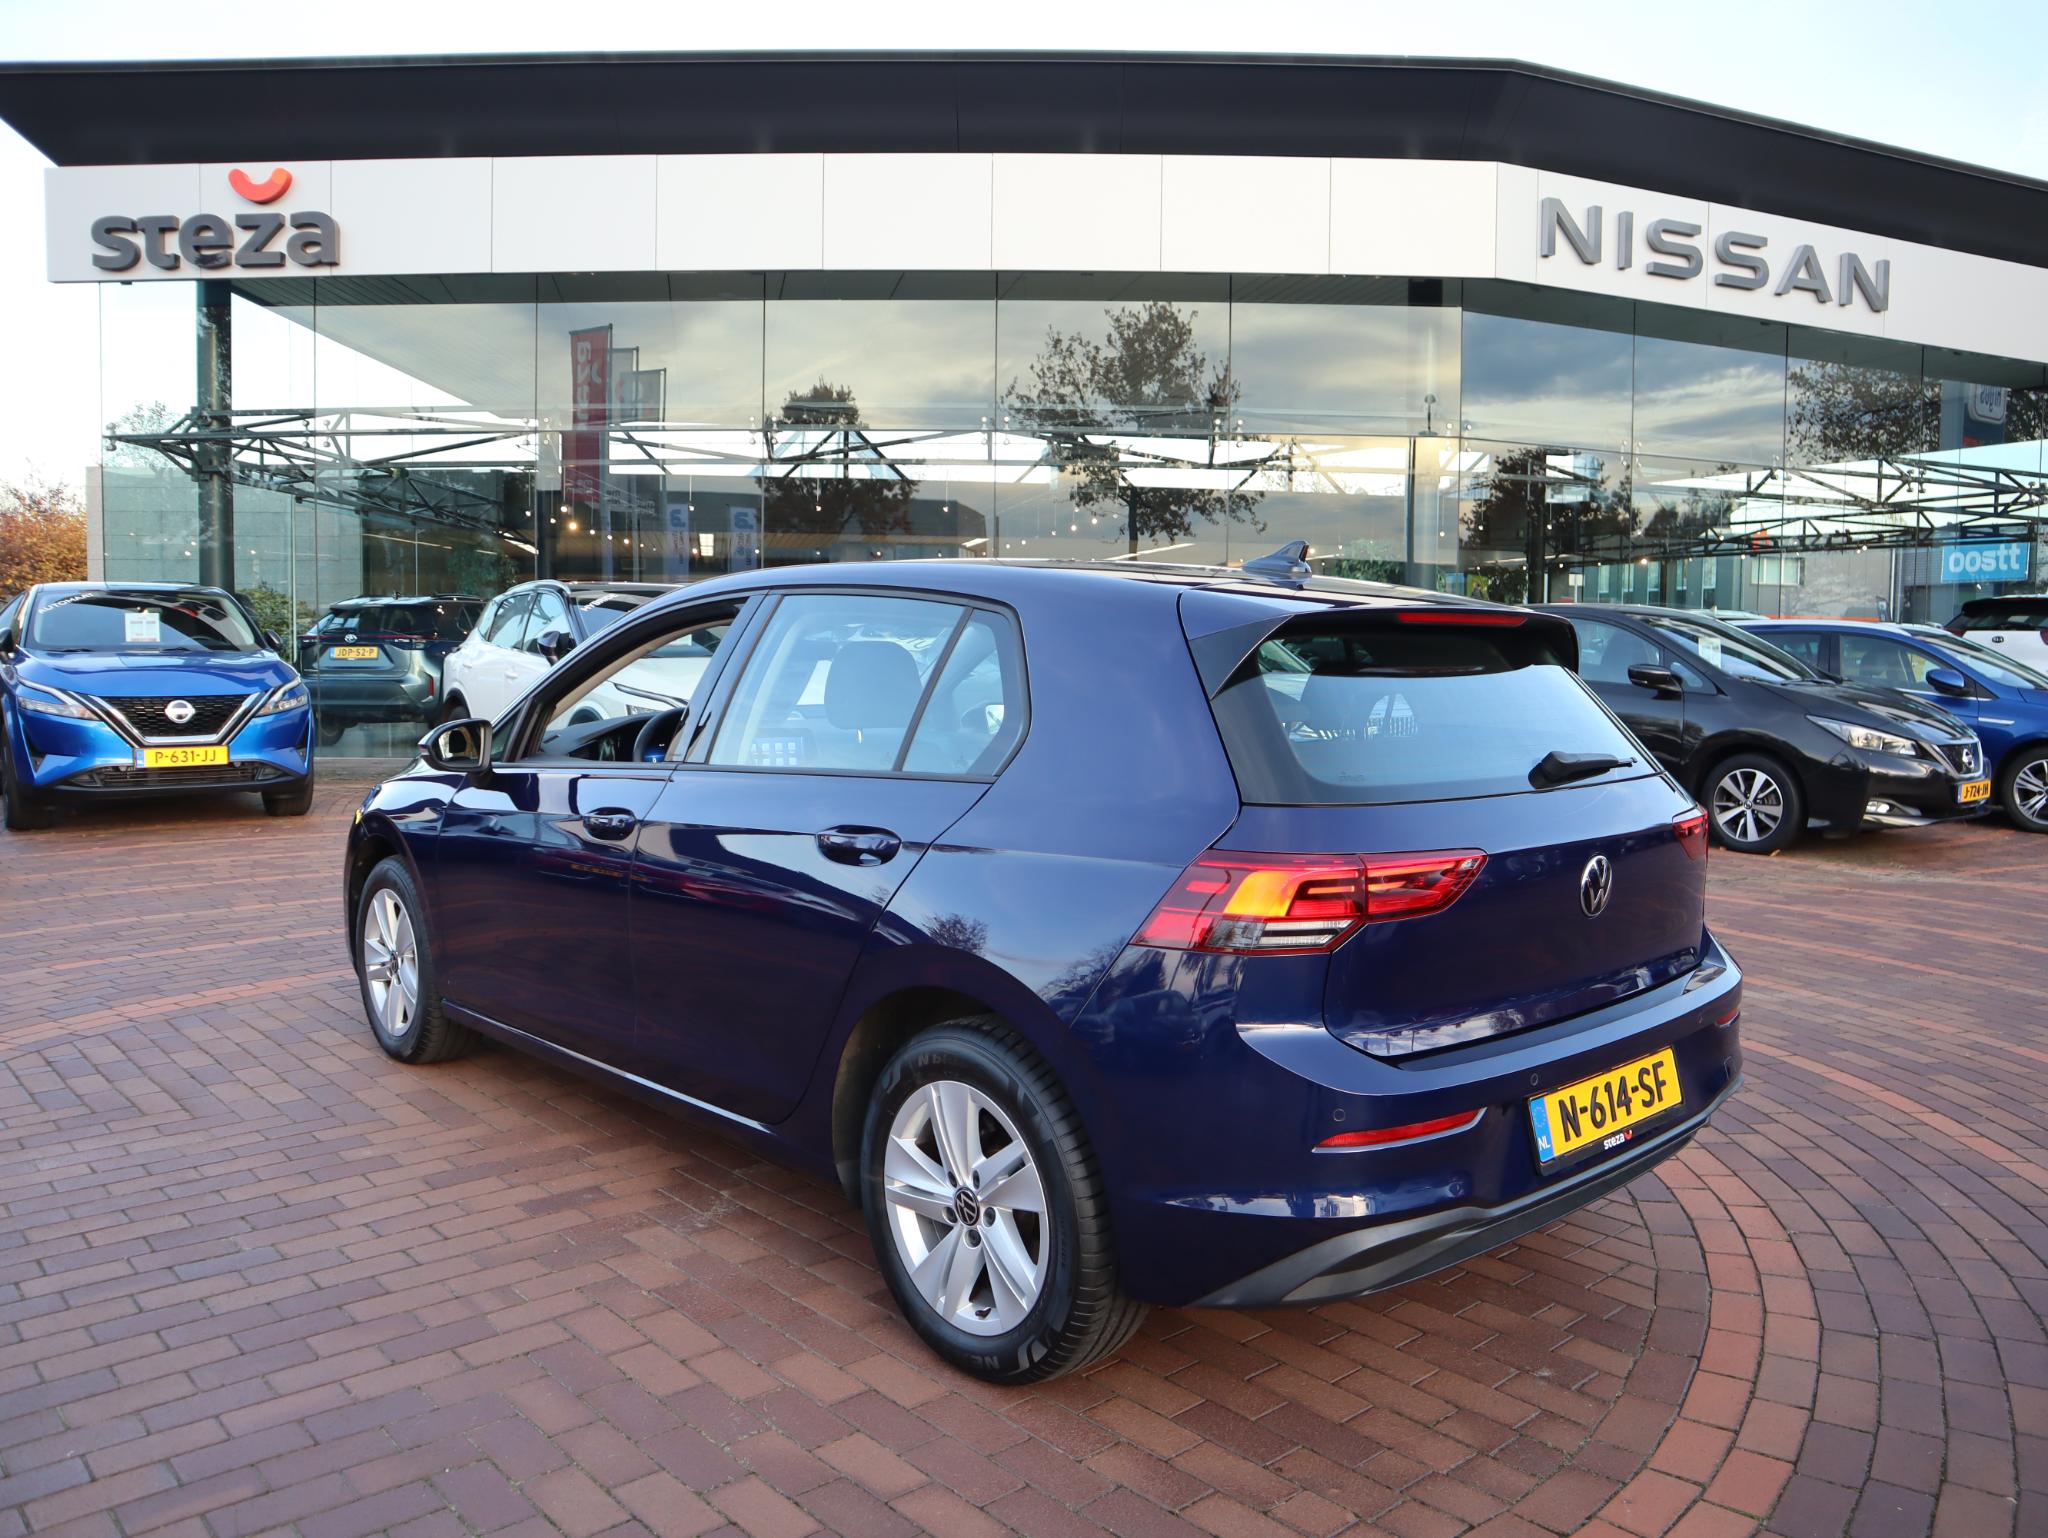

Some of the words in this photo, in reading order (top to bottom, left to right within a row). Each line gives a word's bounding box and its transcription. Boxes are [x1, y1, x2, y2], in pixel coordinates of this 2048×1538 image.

[91, 210, 341, 272] steza
[1541, 197, 1891, 312] NISSAN
[1948, 543, 2021, 573] oostt
[336, 648, 375, 657] JDP-52-P
[155, 749, 216, 764] P-631-JJ
[1538, 1135, 1551, 1151] NL
[1558, 1060, 1667, 1143] N-614-SF
[1603, 1133, 1626, 1150] steza
